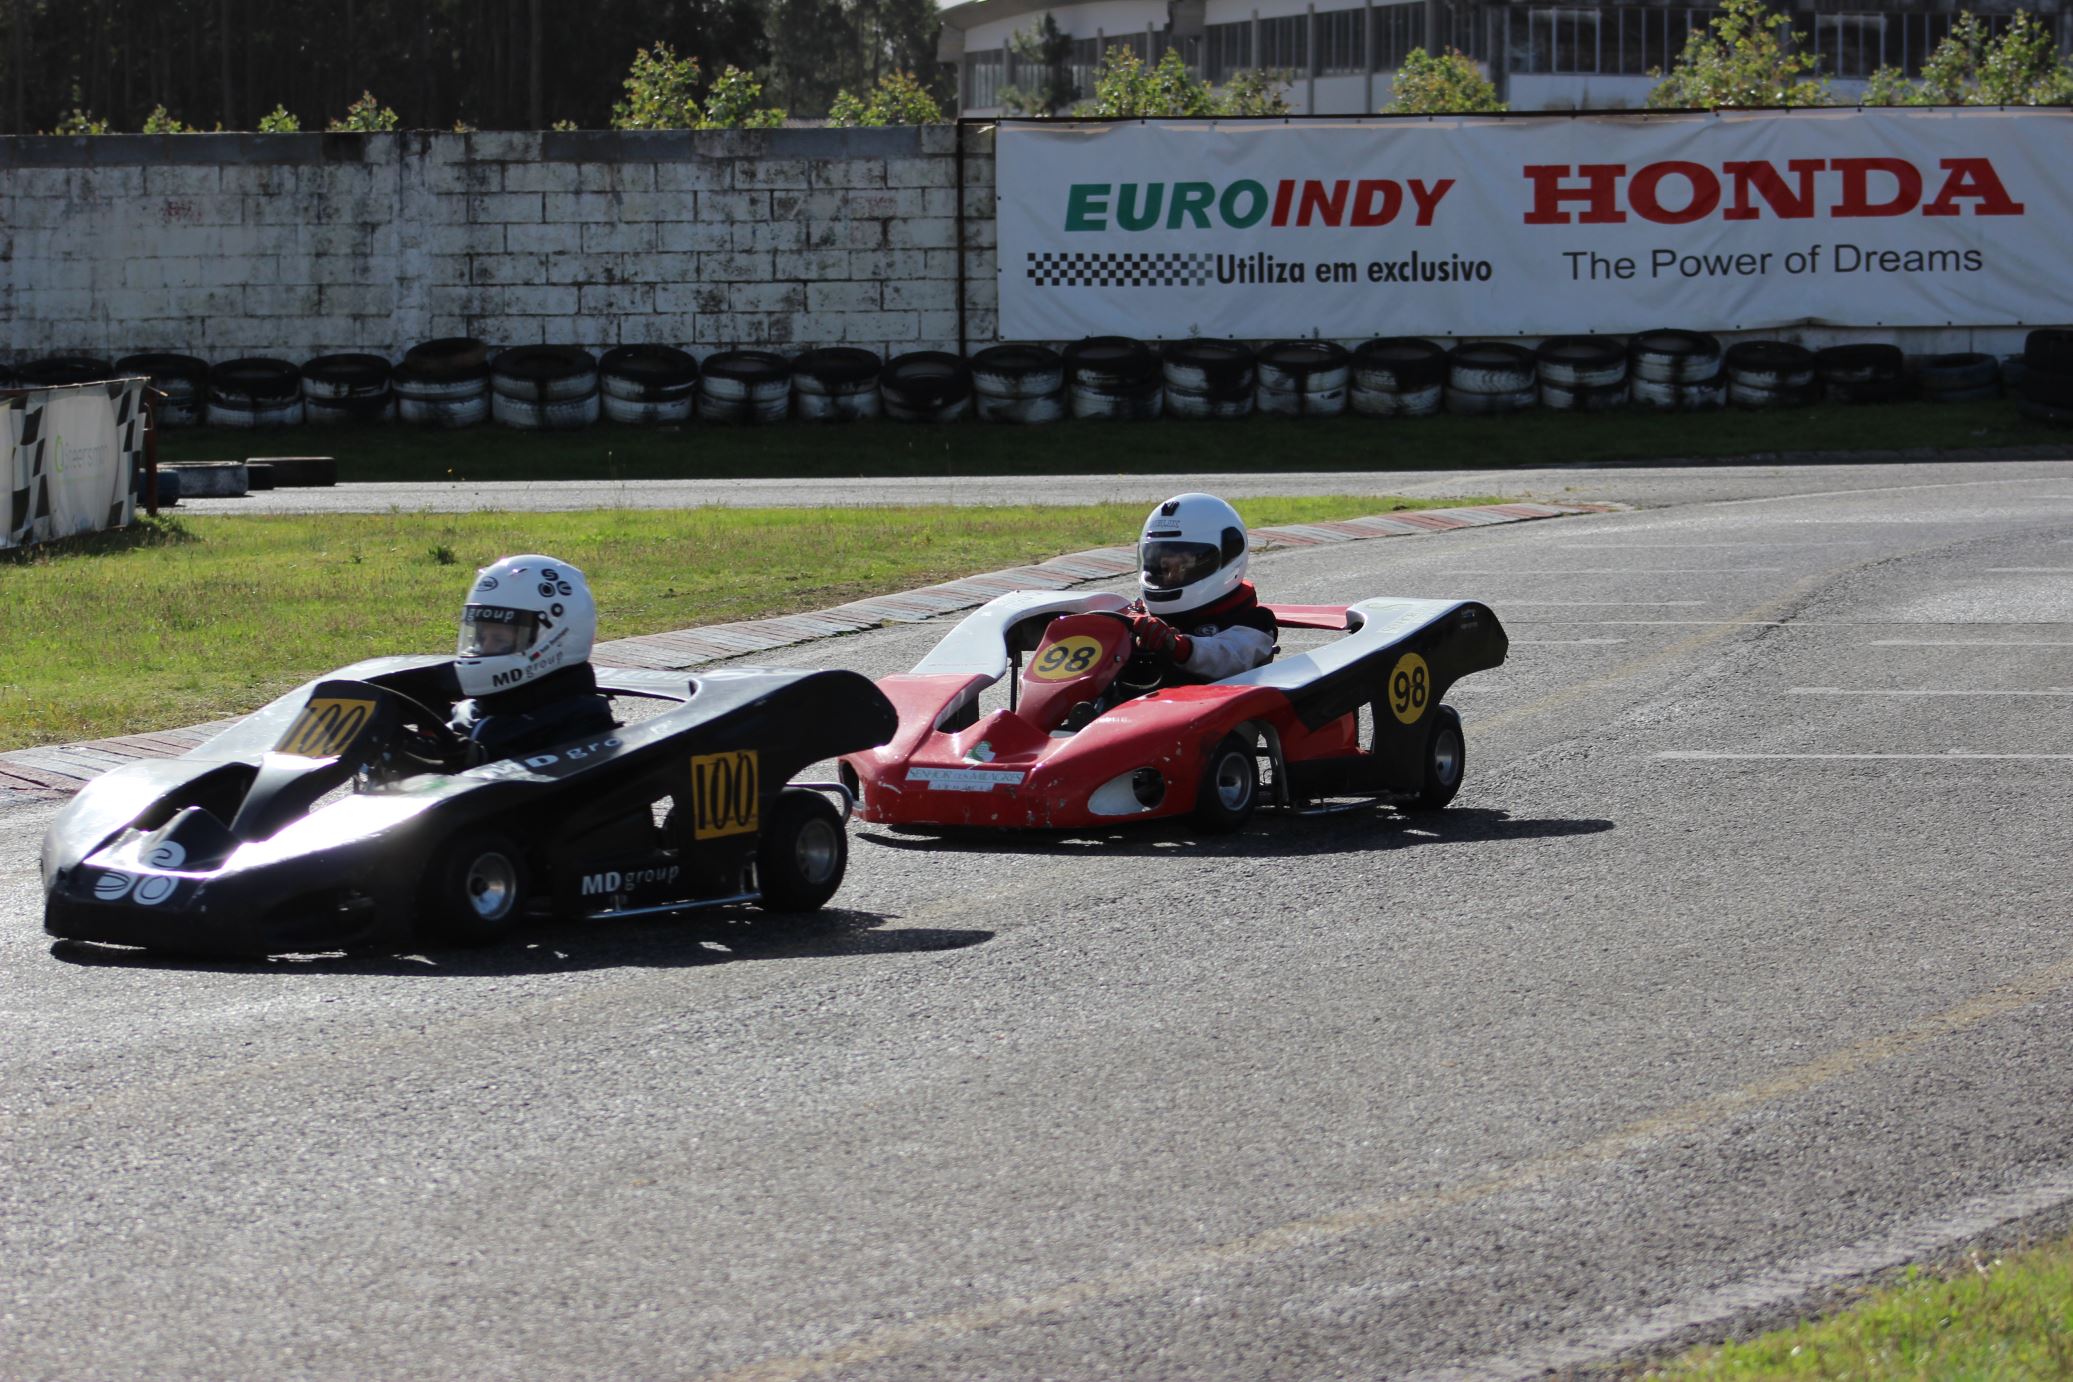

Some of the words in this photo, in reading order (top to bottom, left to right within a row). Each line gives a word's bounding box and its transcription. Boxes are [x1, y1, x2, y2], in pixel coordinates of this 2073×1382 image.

[1064, 179, 1456, 232] EUROINDY
[1523, 158, 2025, 225] HONDA
[1216, 252, 1305, 284] Utiliza
[1315, 262, 1358, 283] em
[1367, 250, 1493, 283] exclusivo
[1562, 250, 1636, 280] The
[1651, 248, 1773, 278] Power
[1784, 244, 1822, 274] of
[1834, 244, 1983, 273] Dreams
[492, 668, 523, 688] MD
[526, 651, 564, 679] group
[1038, 646, 1097, 673] 98
[1393, 666, 1426, 714] 98
[280, 703, 367, 756] 100
[696, 751, 755, 830] 100
[581, 871, 622, 896] MD
[624, 865, 680, 892] group
